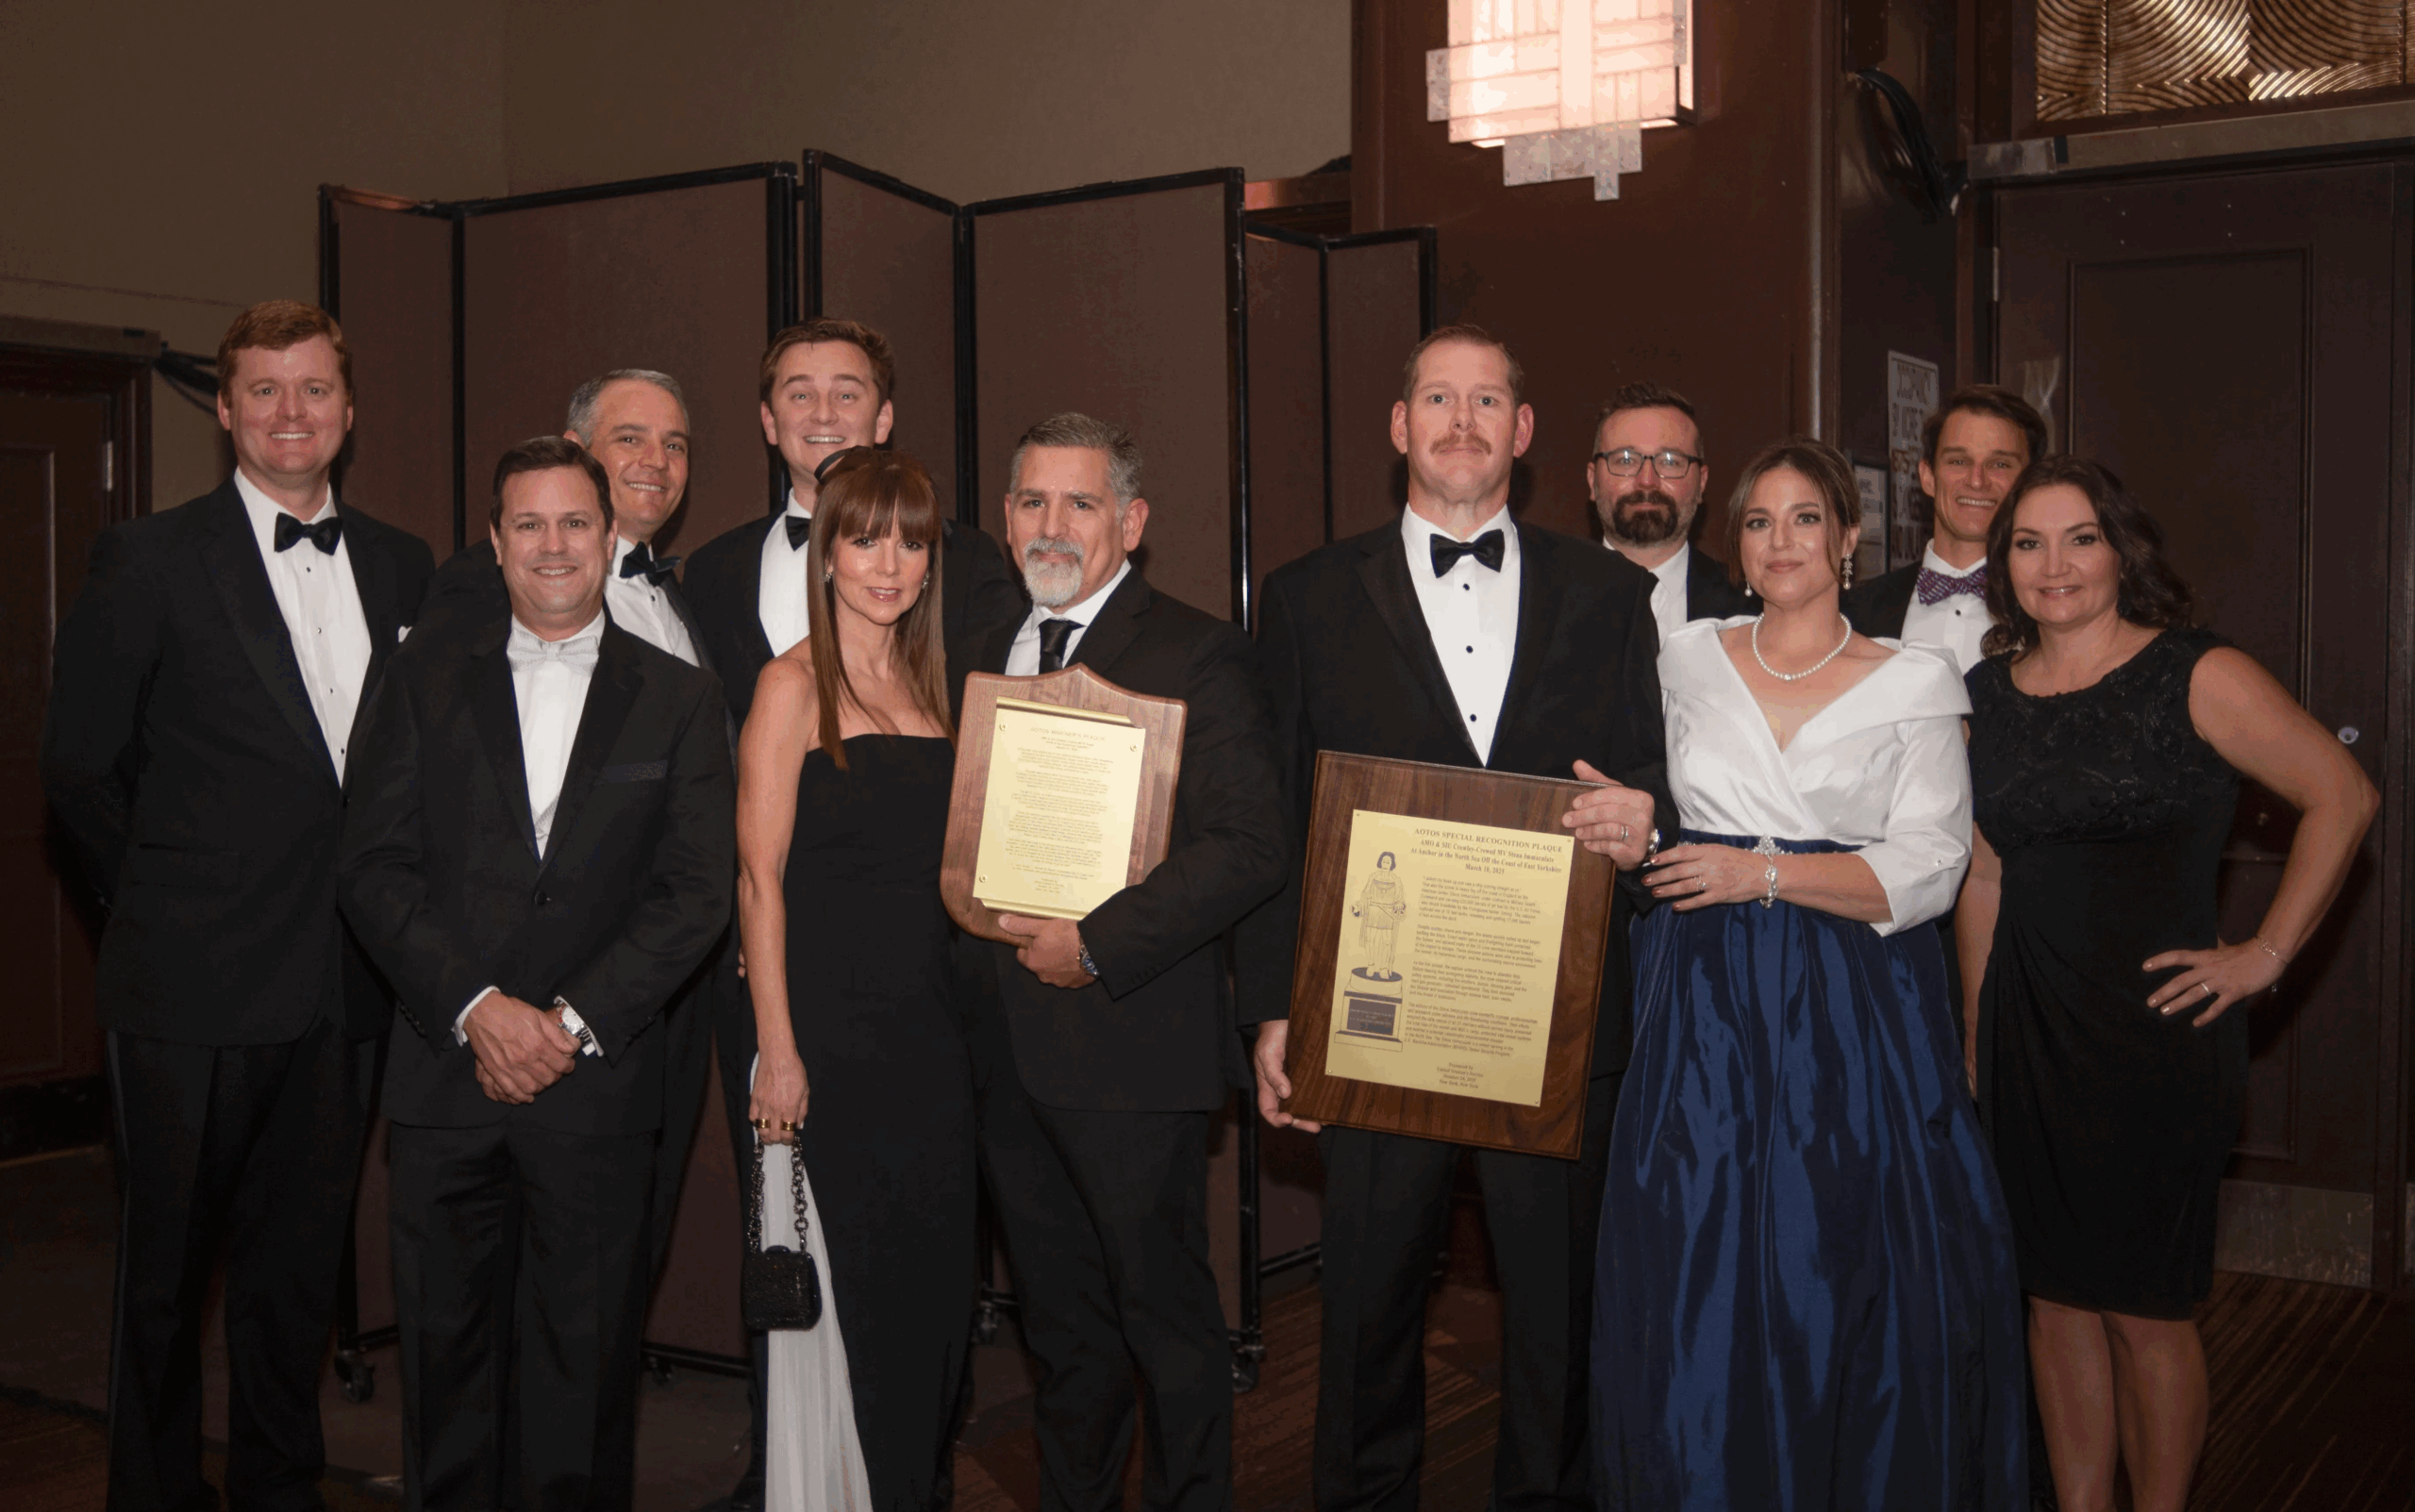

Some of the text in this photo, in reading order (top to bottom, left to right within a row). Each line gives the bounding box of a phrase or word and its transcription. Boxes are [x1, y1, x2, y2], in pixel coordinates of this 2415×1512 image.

[1415, 828, 1562, 852] AOTOS SPECIAL RECOGNITION PLAQUE
[1537, 863, 1562, 872] Yorkshire
